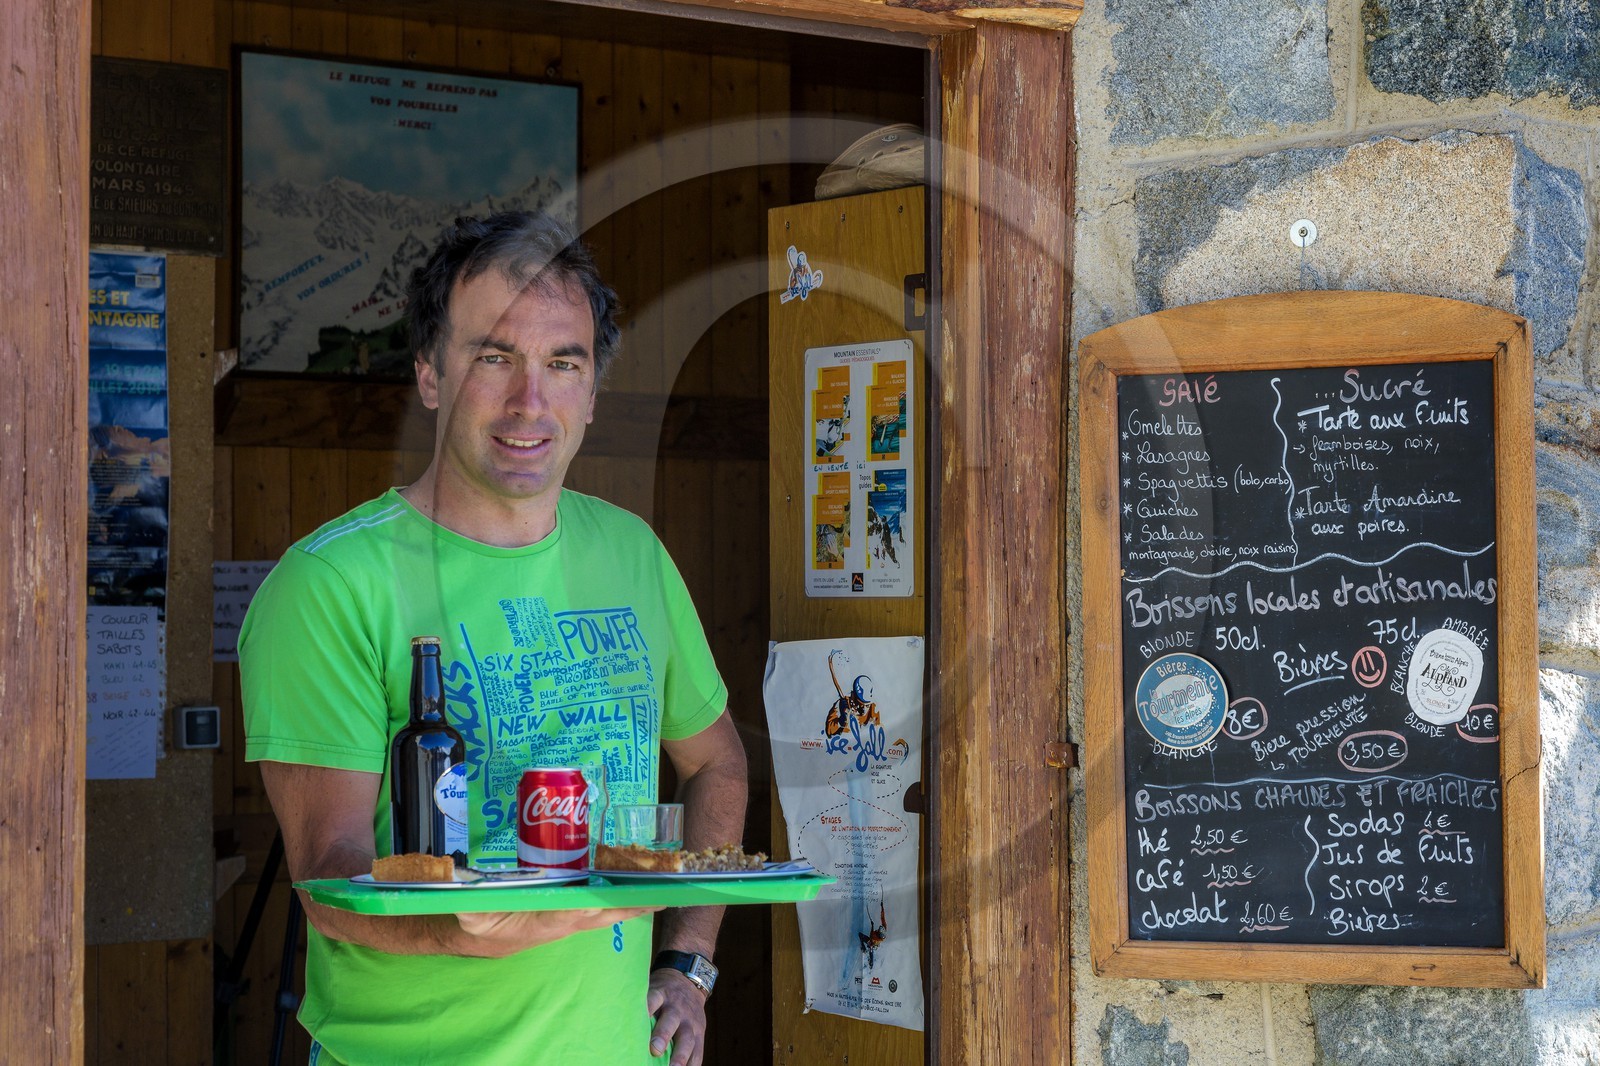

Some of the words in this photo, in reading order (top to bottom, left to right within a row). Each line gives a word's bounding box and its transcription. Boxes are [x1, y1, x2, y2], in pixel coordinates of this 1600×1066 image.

[329, 71, 343, 81] LE
[349, 74, 390, 87] REFUGE
[402, 79, 416, 89] NE
[426, 82, 476, 96] REPREND
[479, 87, 497, 98] PAS
[370, 96, 391, 107] VOS
[398, 100, 458, 113] POUBELLES
[98, 143, 114, 155] DE
[118, 145, 136, 156] CE
[141, 147, 193, 161] REFUGE
[93, 177, 145, 193] MARS
[118, 197, 159, 214] SKIEURS
[263, 254, 325, 293] REMPORTEZ
[297, 284, 317, 301] VOS
[318, 257, 363, 286] ORDURES
[110, 290, 130, 306] ET
[833, 350, 855, 359] MOUNTAIN
[1128, 408, 1203, 438] Omelettes
[1297, 404, 1363, 432] Tarte
[1370, 410, 1406, 430] aux
[1416, 397, 1471, 426] Fruits
[1136, 440, 1211, 474] Lasagnes
[1404, 435, 1442, 456] noix,
[1313, 460, 1380, 484] myrtilles.
[859, 482, 872, 490] guides
[1138, 471, 1229, 502] Spaguettis
[1136, 497, 1199, 519] Quiches
[1299, 485, 1351, 517] Tarte
[1362, 485, 1462, 513] Amandine
[1139, 524, 1205, 544] Salades
[1311, 522, 1345, 537] aux
[1357, 518, 1411, 542] poires.
[1239, 546, 1260, 557] noix
[1125, 586, 1238, 628] Boissons
[1246, 575, 1321, 617] locales
[101, 613, 149, 625] COULEUR
[97, 629, 146, 641] TAILLES
[557, 611, 649, 660] POWER
[1441, 616, 1490, 651] AMBRÉE
[97, 643, 143, 656] SABOTS
[104, 662, 125, 671] KAKI
[520, 650, 568, 676] STAR
[1155, 661, 1188, 678] Bières
[1273, 642, 1349, 684] Bières
[513, 671, 535, 714] POWER
[539, 688, 560, 700] BLUE
[563, 681, 610, 696] GRAMMA
[567, 694, 579, 703] OF
[580, 691, 597, 701] THE
[600, 684, 625, 696] BUGLE
[1138, 674, 1219, 722] Tourmente
[103, 710, 124, 721] NOIR
[497, 712, 547, 738] NEW
[558, 703, 628, 728] WALL
[1295, 692, 1368, 739] pression
[530, 736, 574, 751] BRIDGER
[576, 732, 601, 746] JACK
[1287, 705, 1370, 764] TOURMENTE
[530, 746, 569, 759] FRICTION
[569, 743, 601, 755] SLABS
[530, 754, 580, 767] SUBURBIA
[1254, 782, 1347, 810] CHAUDES
[1355, 783, 1386, 807] ET
[1396, 777, 1499, 812] FRAICHES
[820, 815, 842, 825] STAGES
[1326, 811, 1405, 838] Sodas
[872, 833, 887, 842] glace
[1321, 843, 1364, 867] Jus
[1376, 839, 1404, 864] de
[1418, 834, 1475, 865] Fruits
[1328, 872, 1406, 907] Sirops
[1141, 891, 1229, 931] chocolat
